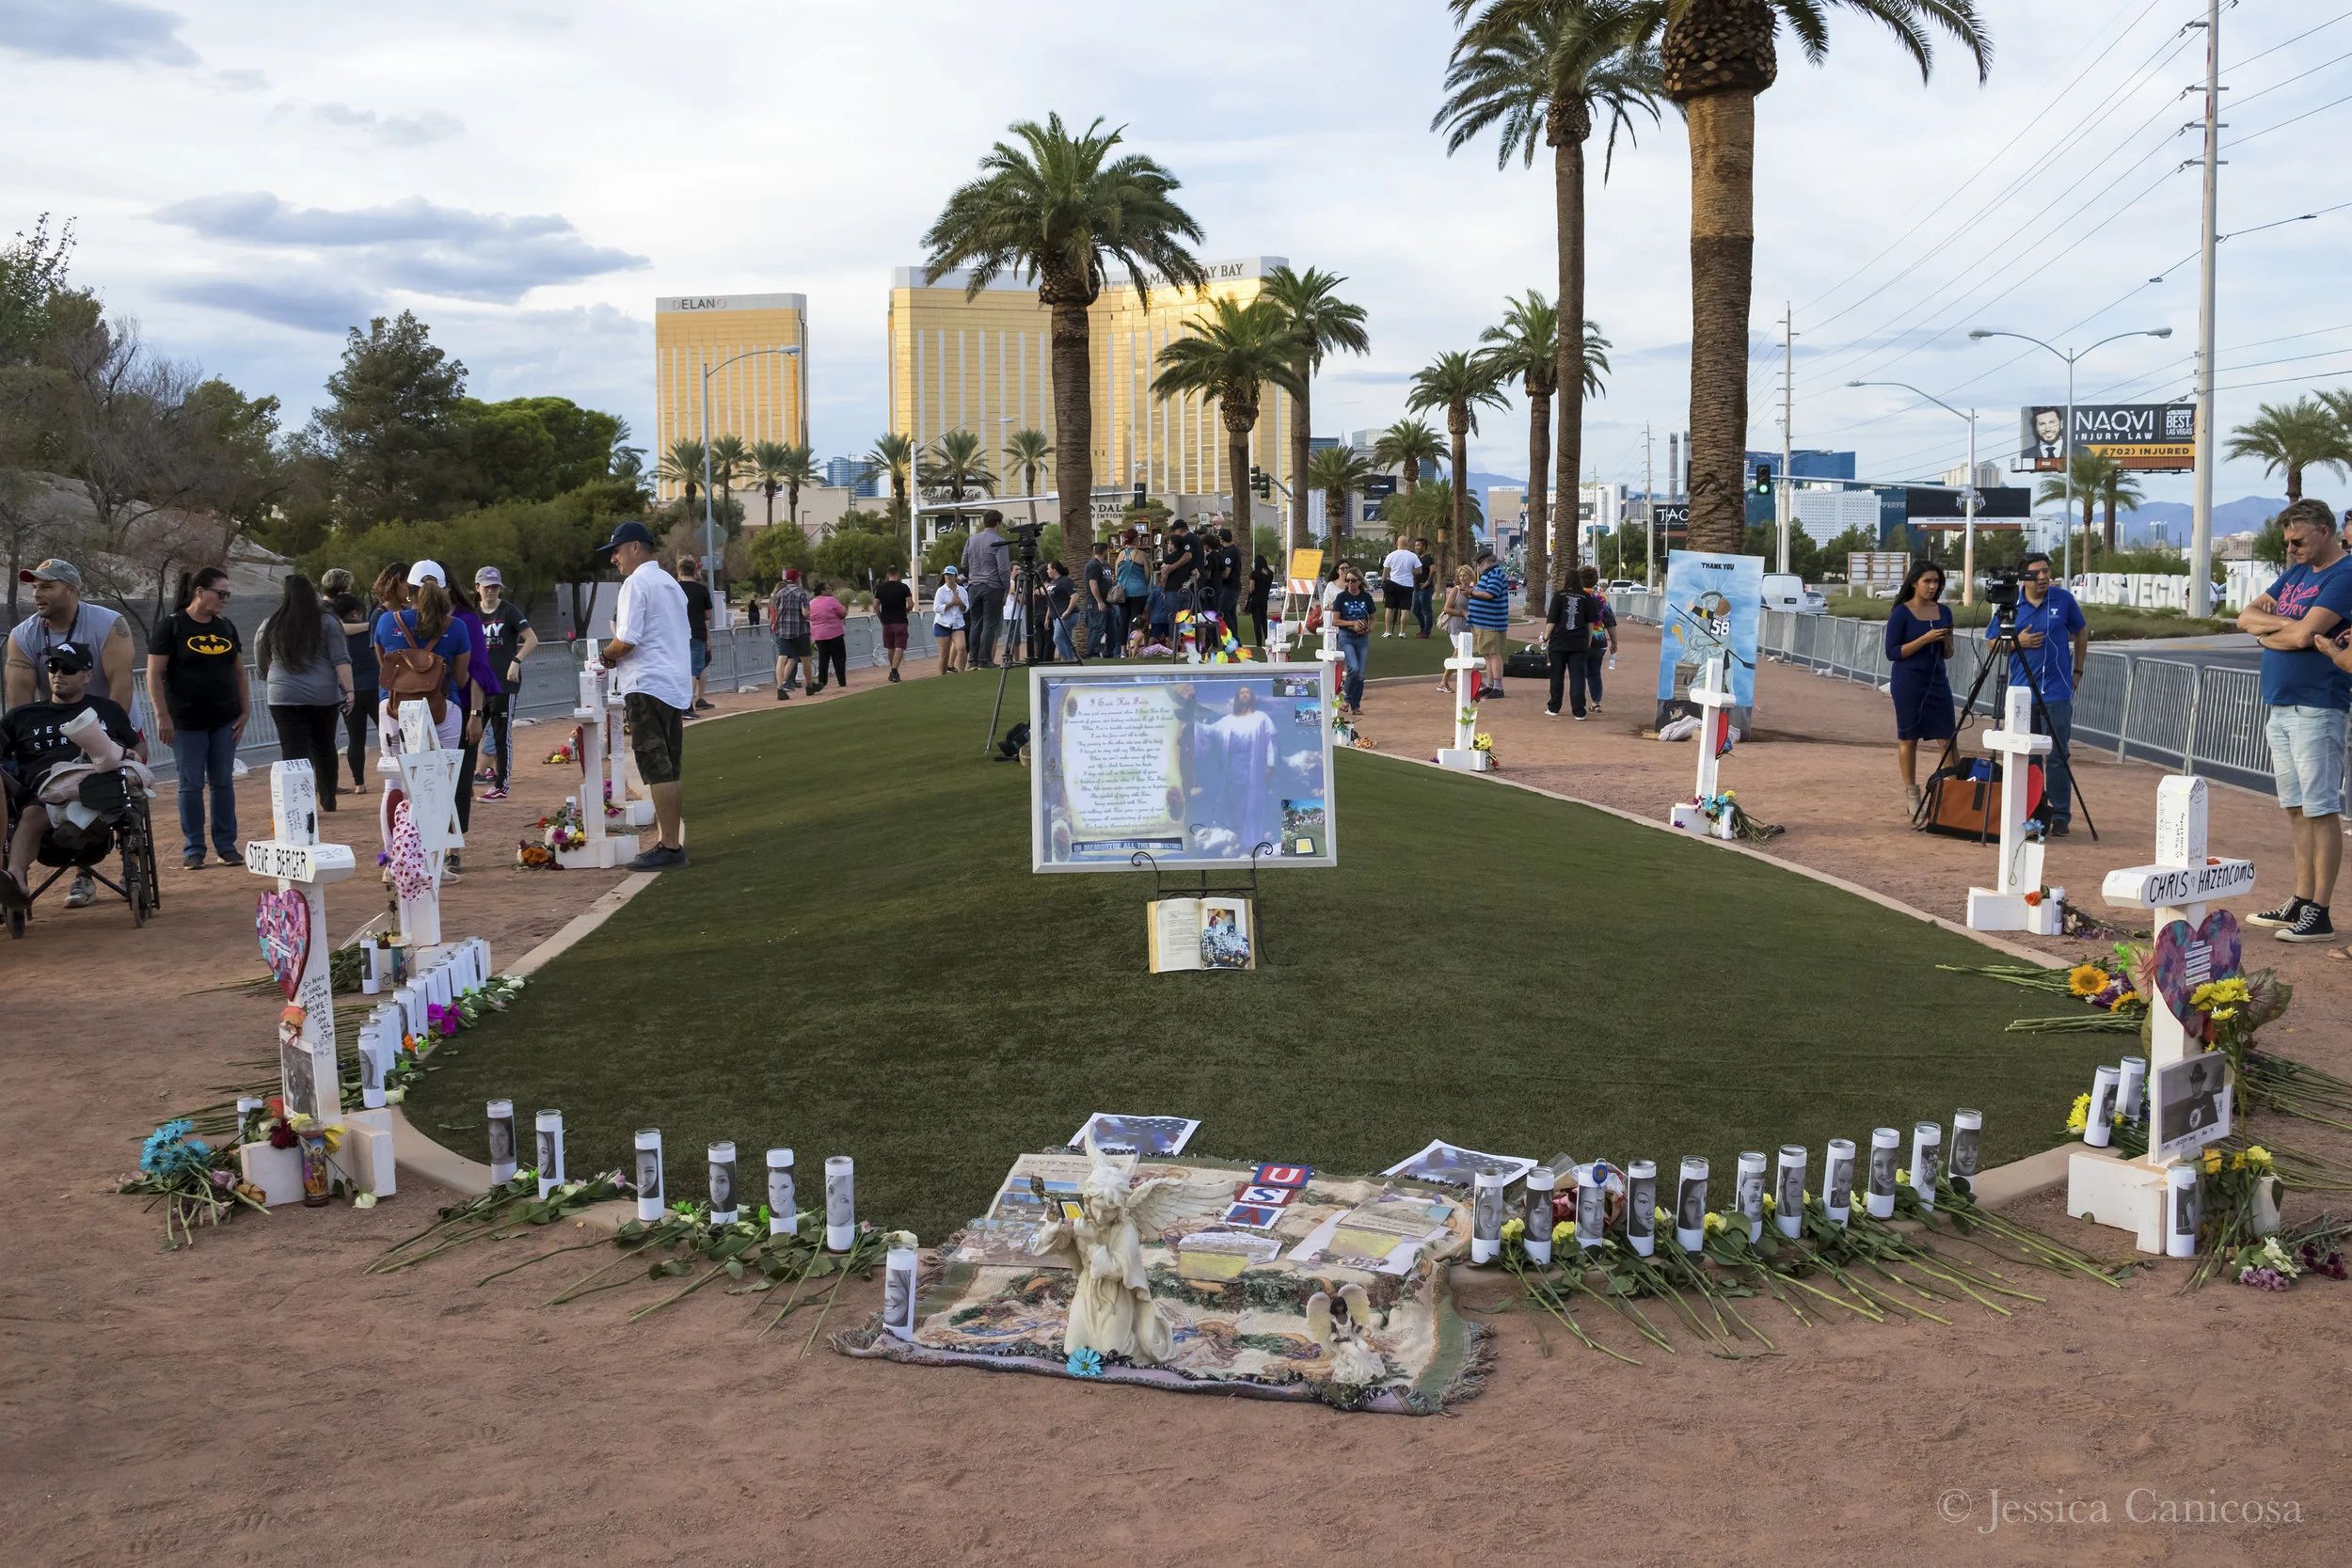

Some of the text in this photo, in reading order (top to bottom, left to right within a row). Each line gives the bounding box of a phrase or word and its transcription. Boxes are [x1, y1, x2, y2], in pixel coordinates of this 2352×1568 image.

[1220, 263, 1244, 277] BAY
[671, 297, 726, 310] DELANO
[2075, 409, 2153, 433] NAQVI
[2166, 415, 2191, 428] BEST
[2075, 432, 2153, 441] INJURY LAW
[2139, 447, 2190, 456] INJURED
[1701, 562, 1722, 570] THANK
[2086, 573, 2125, 606] LAS
[1710, 619, 1730, 635] 58
[248, 843, 308, 880] STEVE BERGER
[2149, 871, 2189, 903] CHRIS
[309, 984, 323, 994] HAVE
[1268, 1167, 1300, 1182] U
[1248, 1188, 1280, 1202] S
[1229, 1207, 1262, 1226] A
